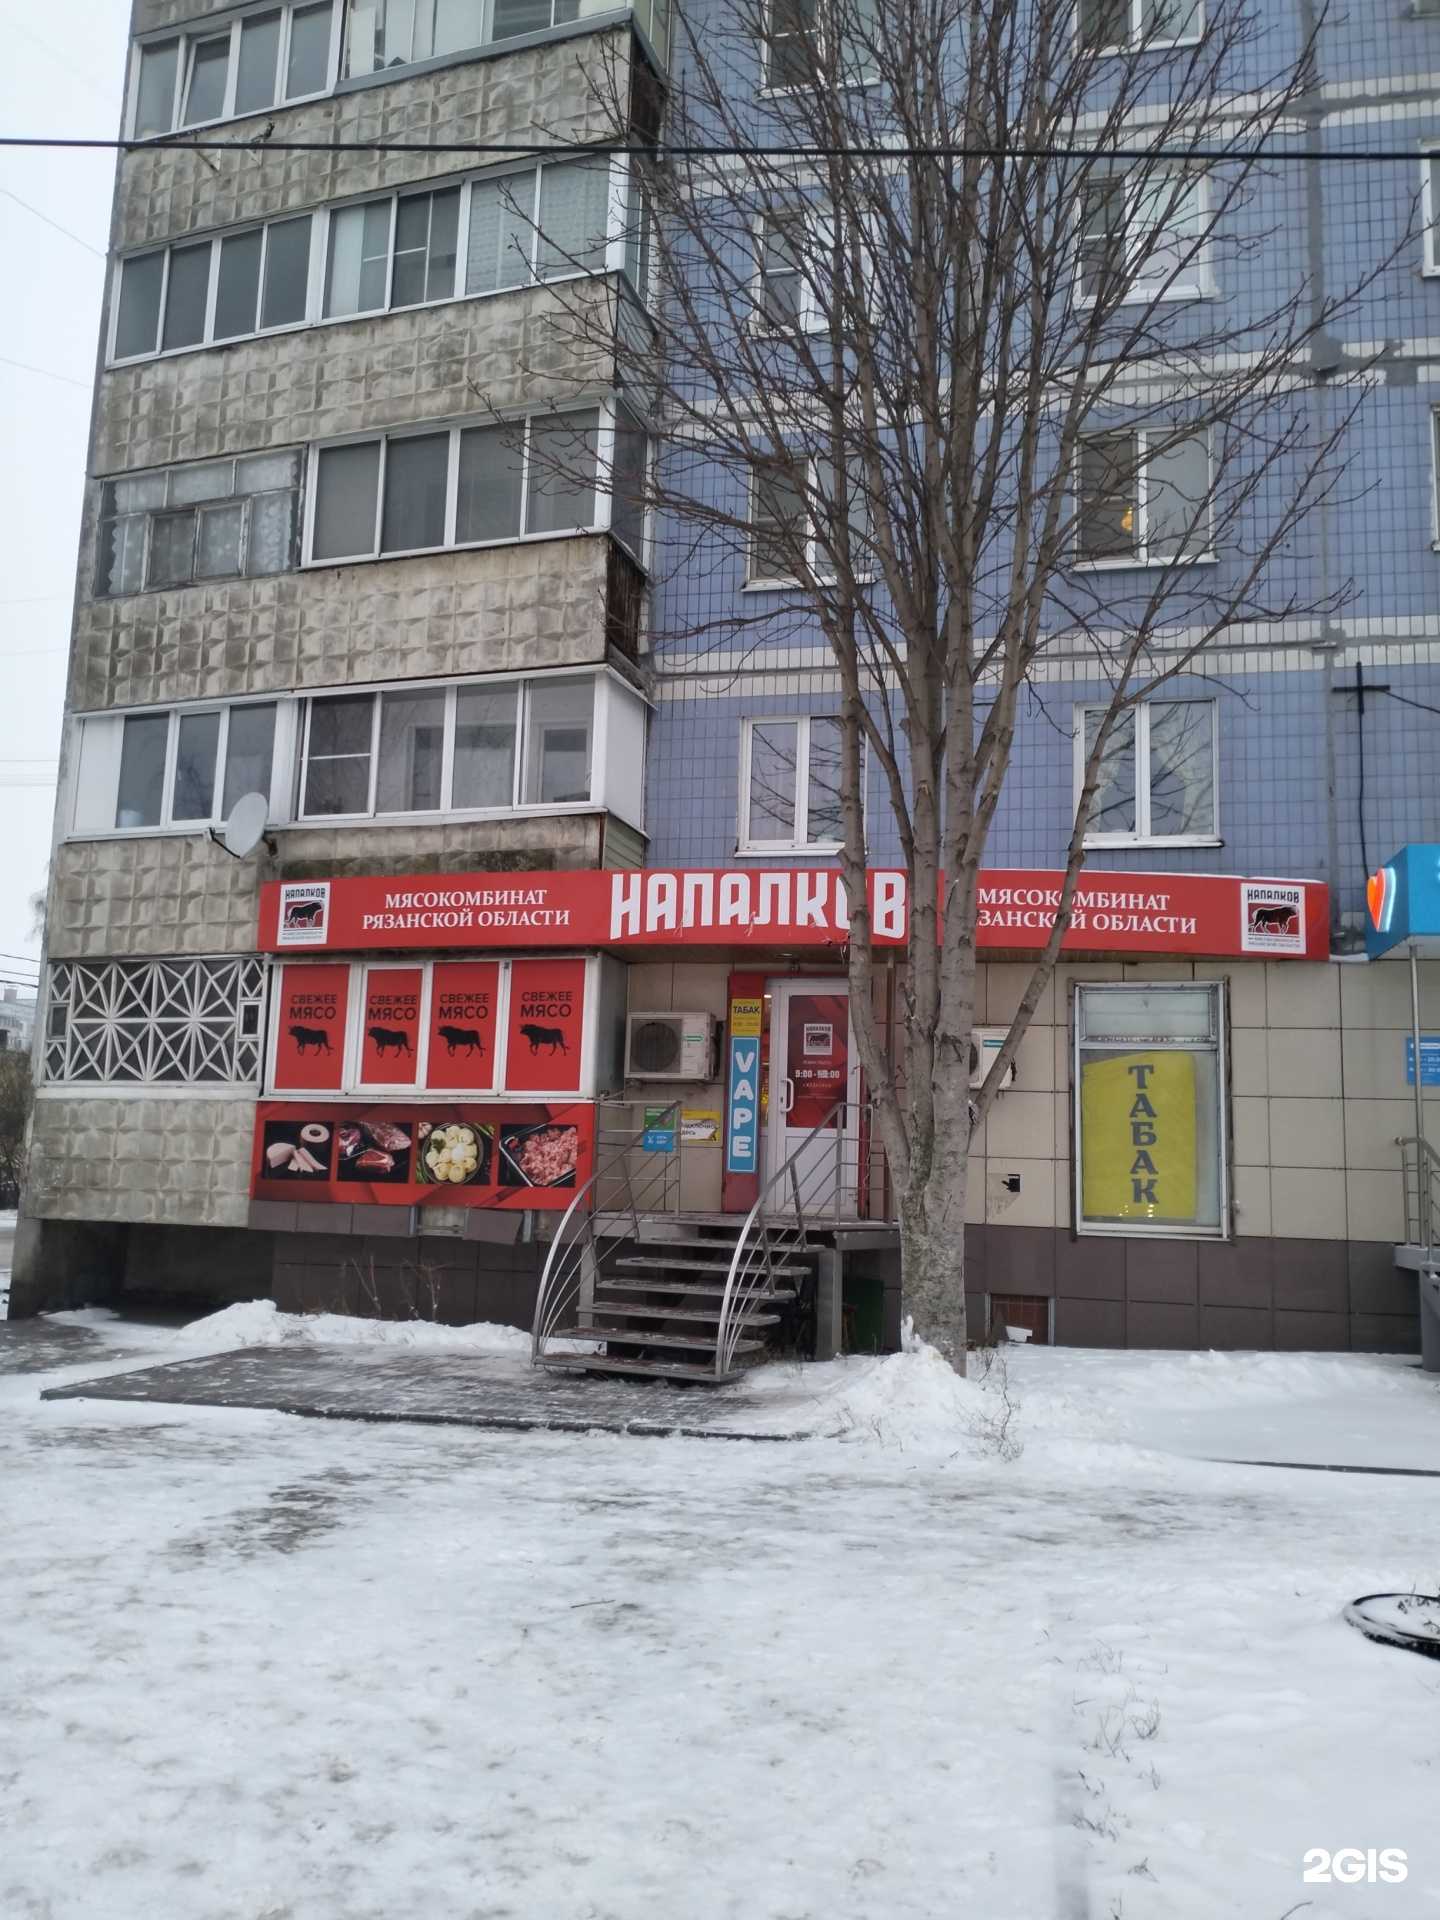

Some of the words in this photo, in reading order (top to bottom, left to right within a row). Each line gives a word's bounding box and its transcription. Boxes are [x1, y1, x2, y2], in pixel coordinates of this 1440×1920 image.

[285, 887, 326, 900] НАПАЛКОВ
[385, 889, 547, 909] МЯСОКОМБИНАТ
[1247, 889, 1300, 904] НАПАЛКОВ
[362, 908, 473, 930] РЯЗАНСКОЙ
[478, 910, 570, 926] ОБЛАСТИ
[978, 909, 1087, 930] ЗАНСКЙ
[1092, 913, 1198, 935] ОБЛАСТИ
[291, 993, 337, 1005] СВЕЖЕЕ
[369, 995, 417, 1006] СВЕЖЕЕ
[439, 993, 489, 1004] СВЕЖЕЕ
[521, 991, 573, 1002] СВЕЖЕЕ
[289, 1006, 337, 1020] МЯСО
[368, 1007, 417, 1021] МЯСО
[438, 1005, 489, 1020] МЯСО
[519, 1004, 572, 1018] МЯСО
[733, 1006, 760, 1014] ТАБАК
[732, 1051, 756, 1158] VAPE
[1127, 1064, 1159, 1205] ТАБАК
